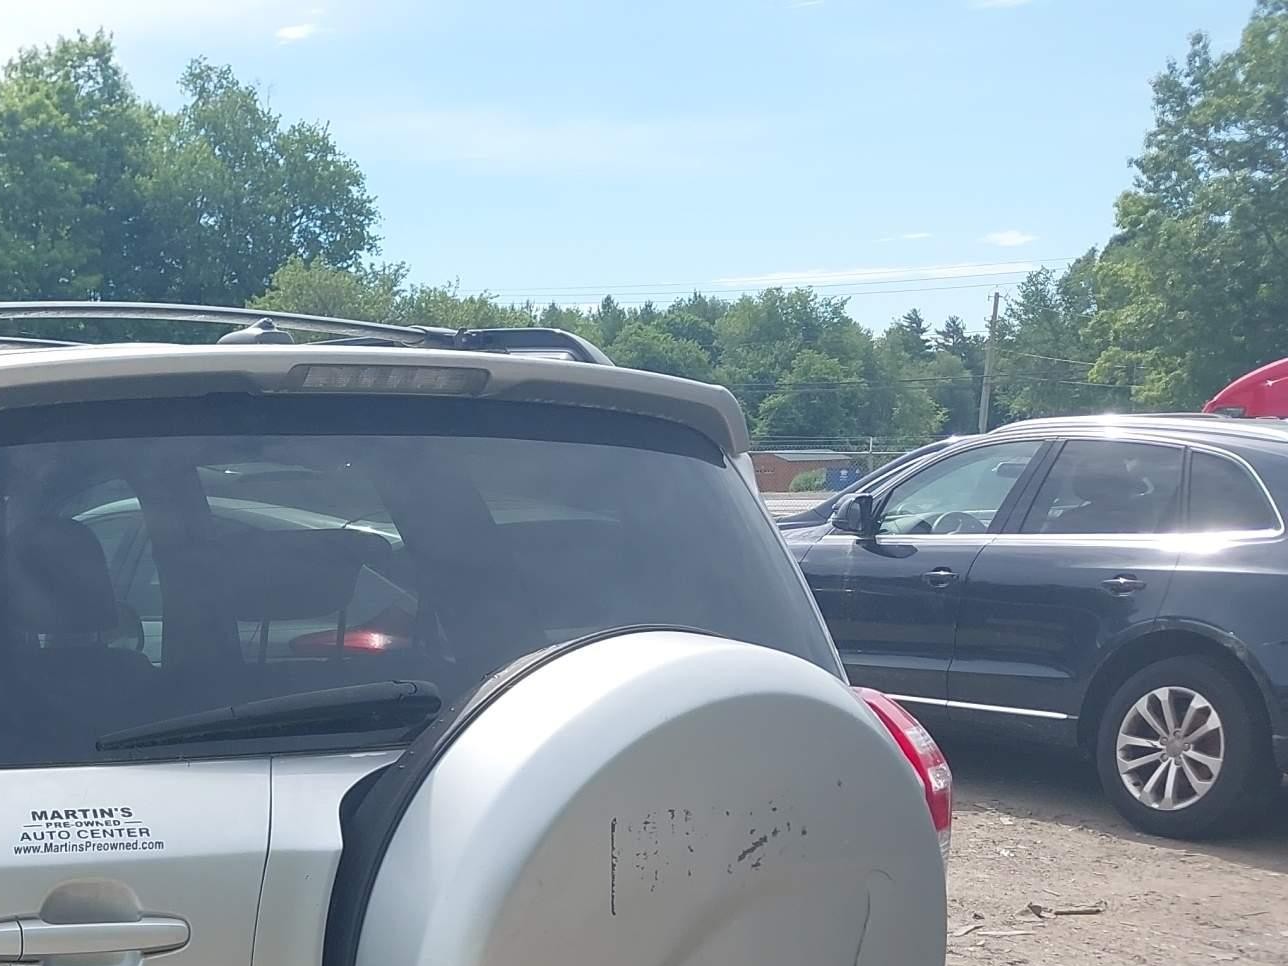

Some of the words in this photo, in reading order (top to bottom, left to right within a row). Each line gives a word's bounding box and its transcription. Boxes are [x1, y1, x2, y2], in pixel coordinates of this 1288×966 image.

[31, 807, 133, 821] MARTIN'S
[45, 820, 121, 829] PRE-OWNED
[20, 830, 71, 842] AUTO
[76, 827, 151, 839] CENTER
[13, 840, 164, 855] www.MartinsPreowned.com
